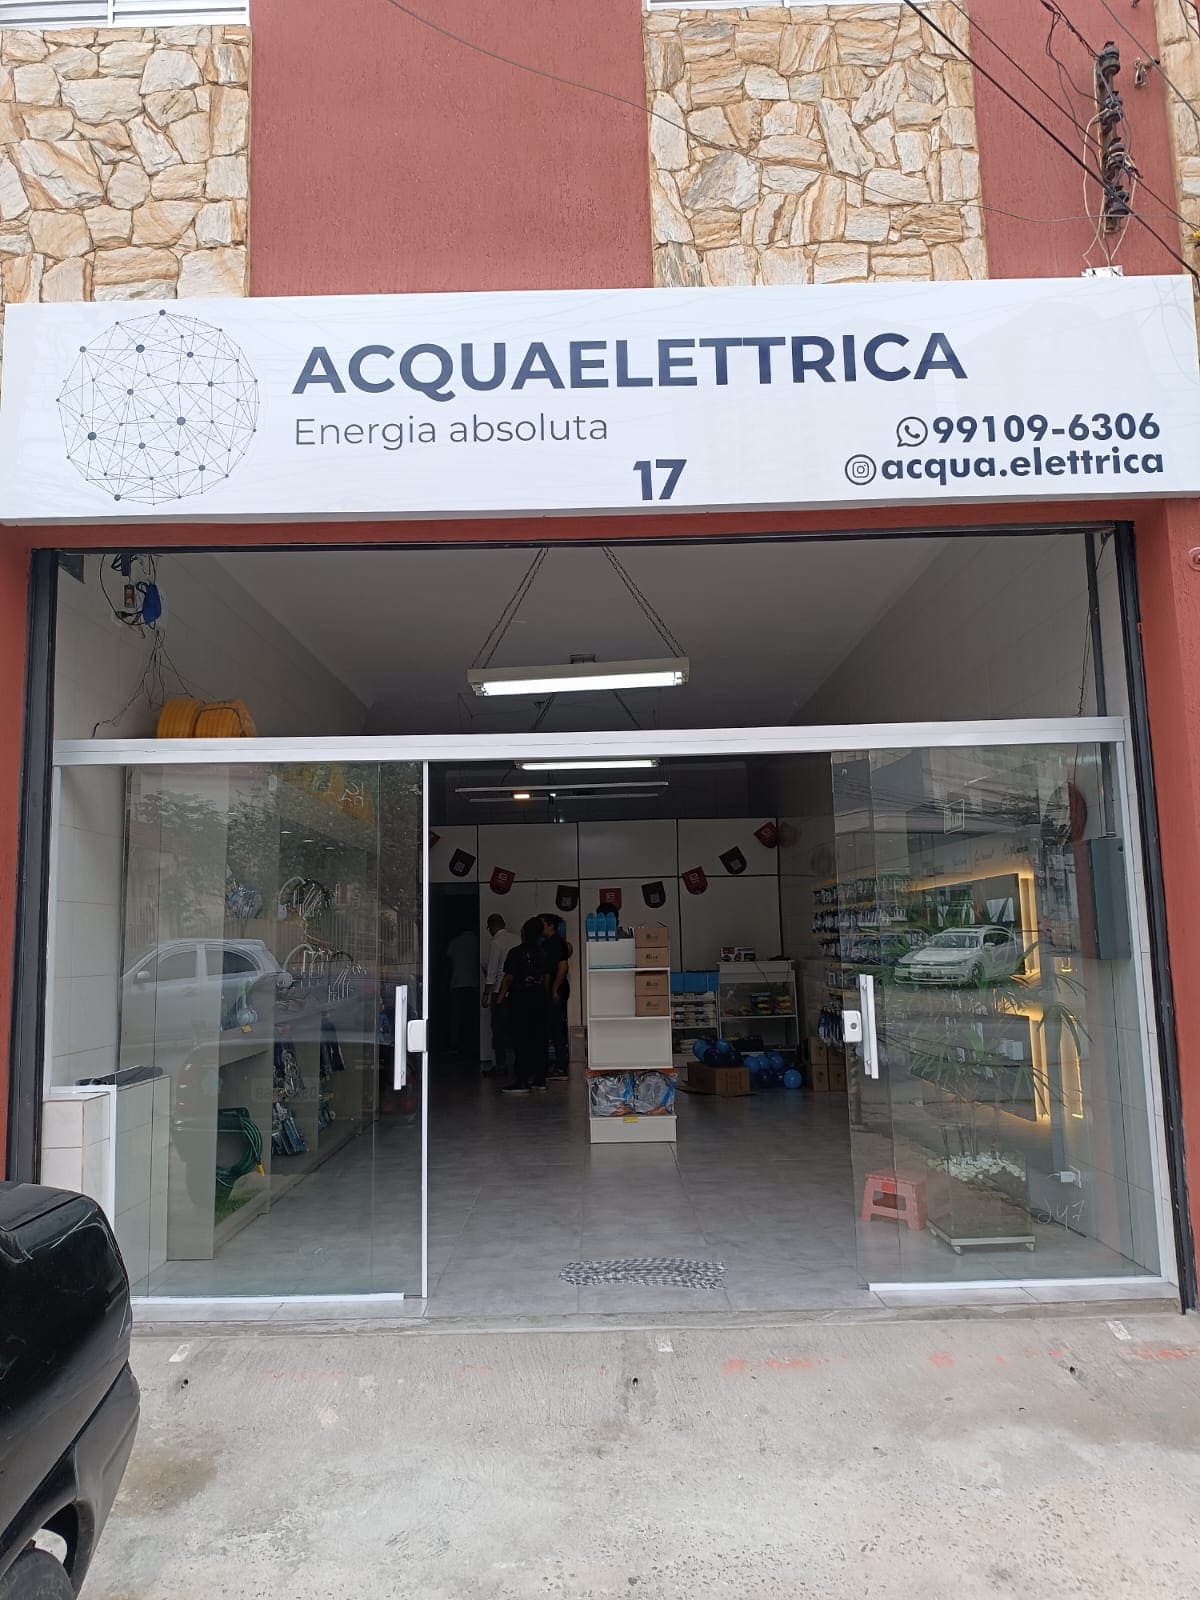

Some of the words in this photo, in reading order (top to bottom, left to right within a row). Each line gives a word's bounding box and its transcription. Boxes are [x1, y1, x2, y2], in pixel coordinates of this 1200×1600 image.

[292, 333, 967, 403] ACQUAELETTRICA
[296, 415, 436, 451] Energia
[450, 413, 607, 443] absoluta
[933, 413, 1160, 443] 99109-6306
[633, 459, 687, 500] 17
[881, 446, 1164, 486] acqua.elettrica
